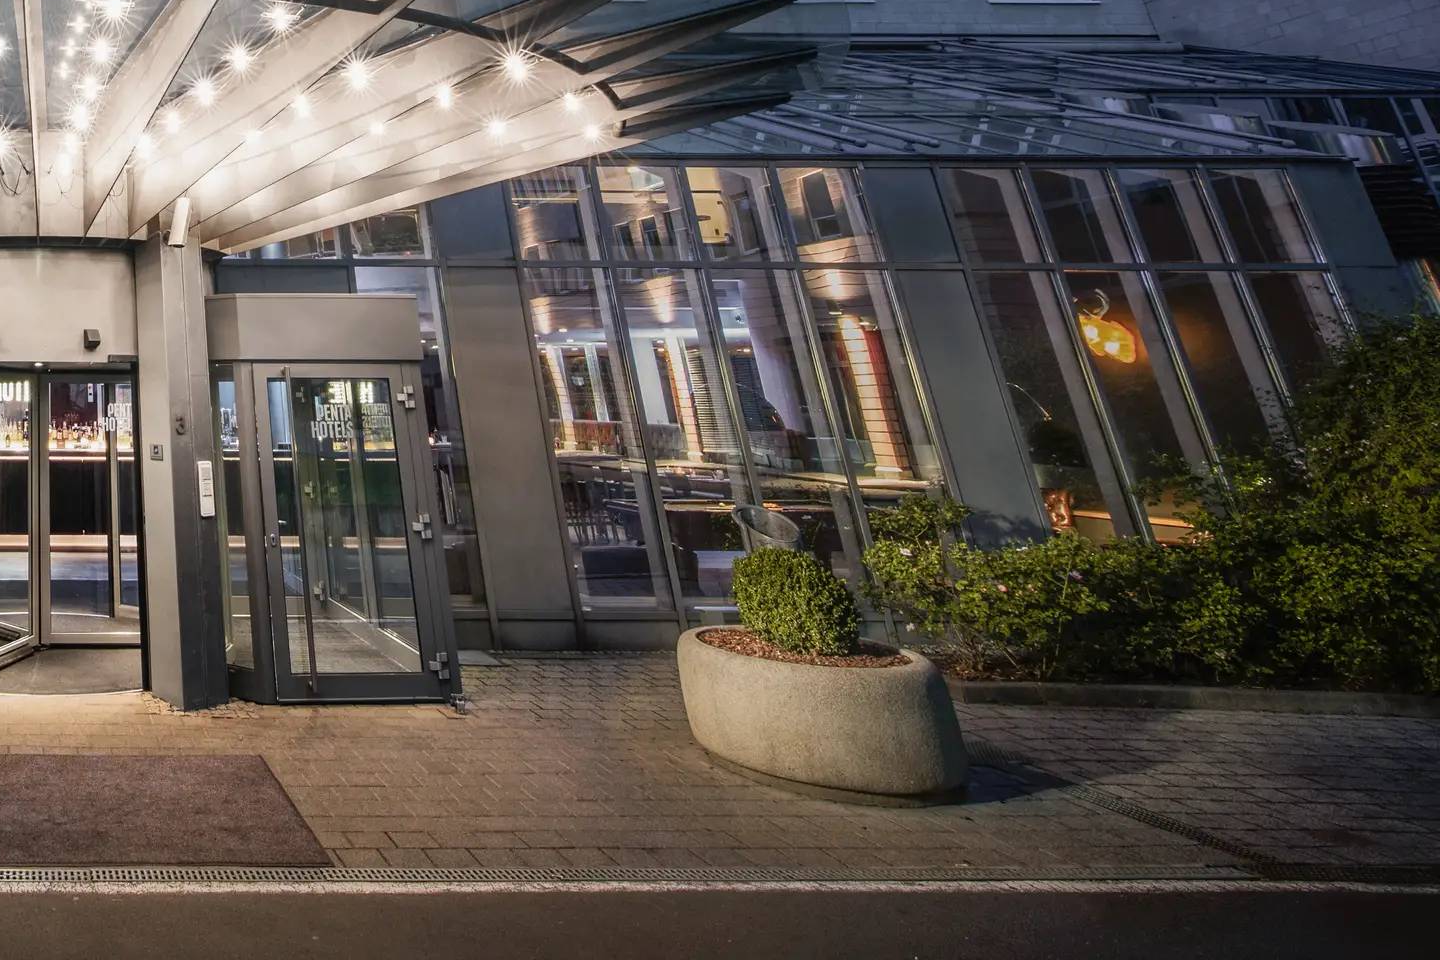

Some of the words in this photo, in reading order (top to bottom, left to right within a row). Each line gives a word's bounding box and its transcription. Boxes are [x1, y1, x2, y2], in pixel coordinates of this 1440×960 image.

[107, 402, 132, 418] PENT
[316, 402, 352, 421] PENTA
[311, 420, 354, 439] HOTELS
